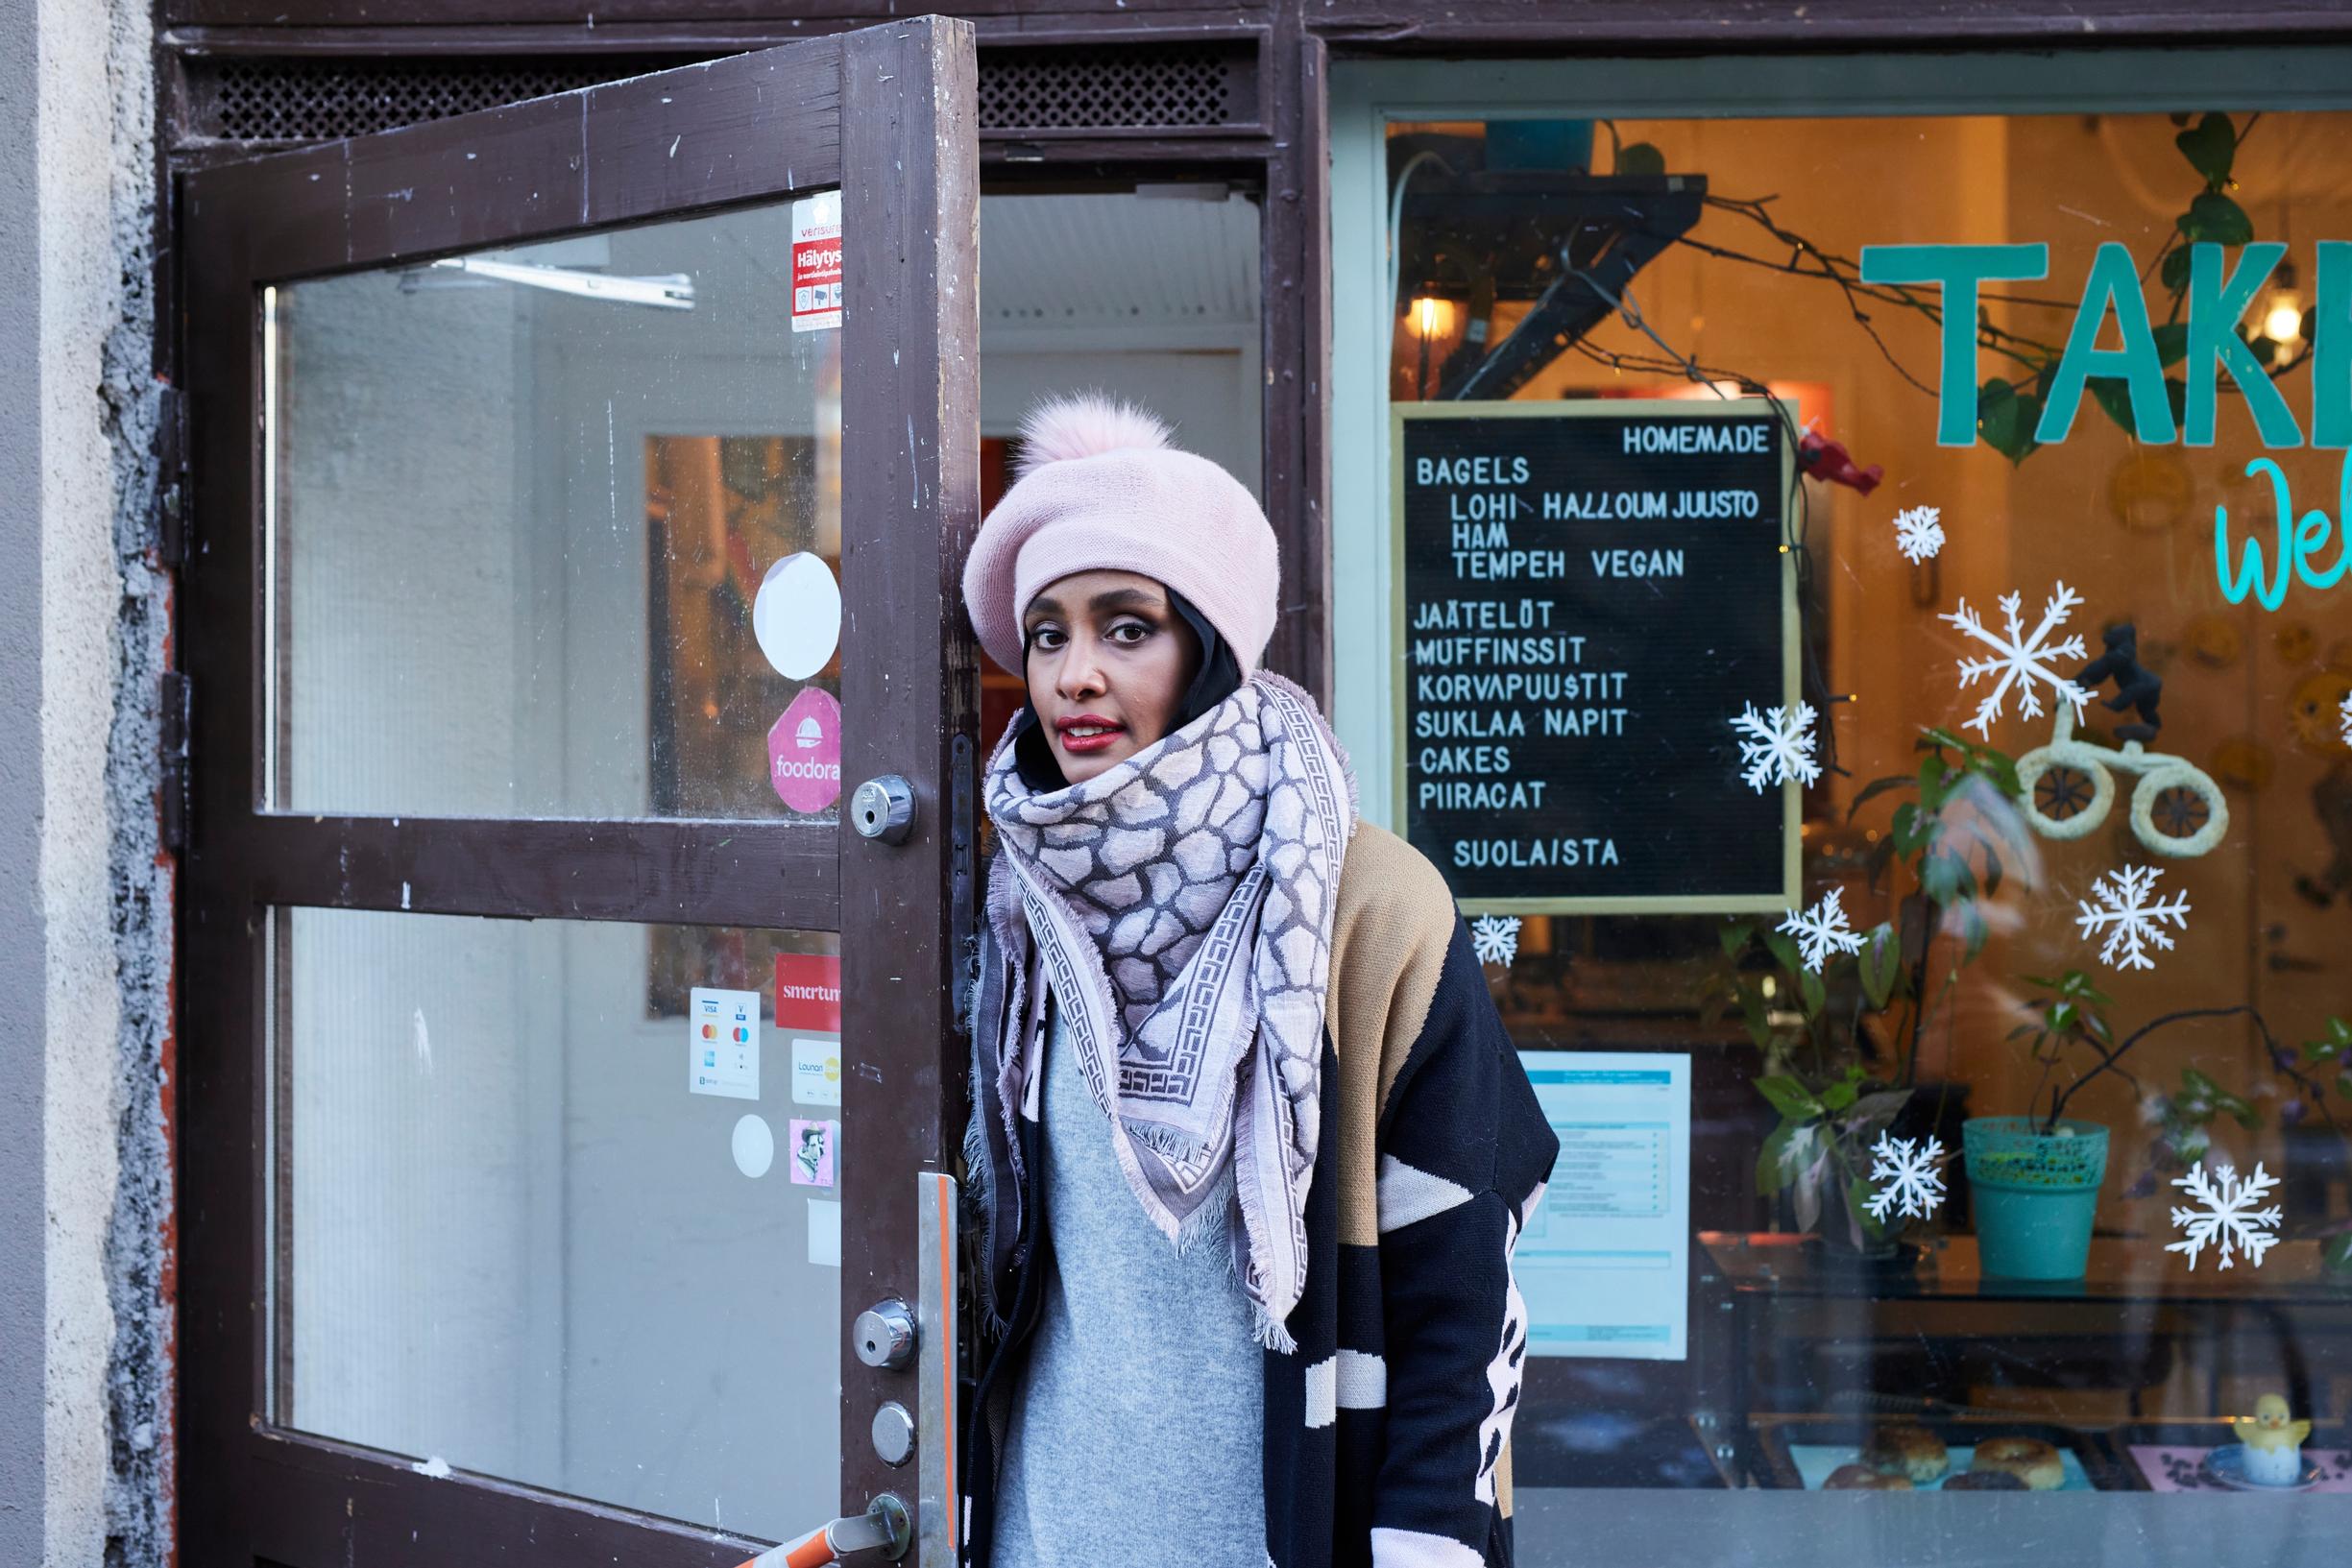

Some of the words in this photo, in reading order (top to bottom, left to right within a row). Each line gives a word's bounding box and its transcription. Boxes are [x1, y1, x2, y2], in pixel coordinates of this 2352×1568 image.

[1624, 425, 1768, 452] HOMEMADE
[1418, 457, 1529, 485] BAGELS
[1451, 494, 1515, 520] LOHI
[1453, 522, 1509, 548] HAM
[1452, 551, 1564, 580] TEMPEH
[1591, 550, 1683, 577] VEGAN
[1416, 637, 1586, 664] MUFFINSSIT
[1416, 711, 1524, 737] SUKLAA
[1545, 709, 1627, 736] NAPIT
[776, 755, 840, 780] foodora
[1420, 746, 1510, 774] CAKES
[1420, 782, 1545, 808] PIIRACAT
[1454, 838, 1618, 866] SUOLAISTA
